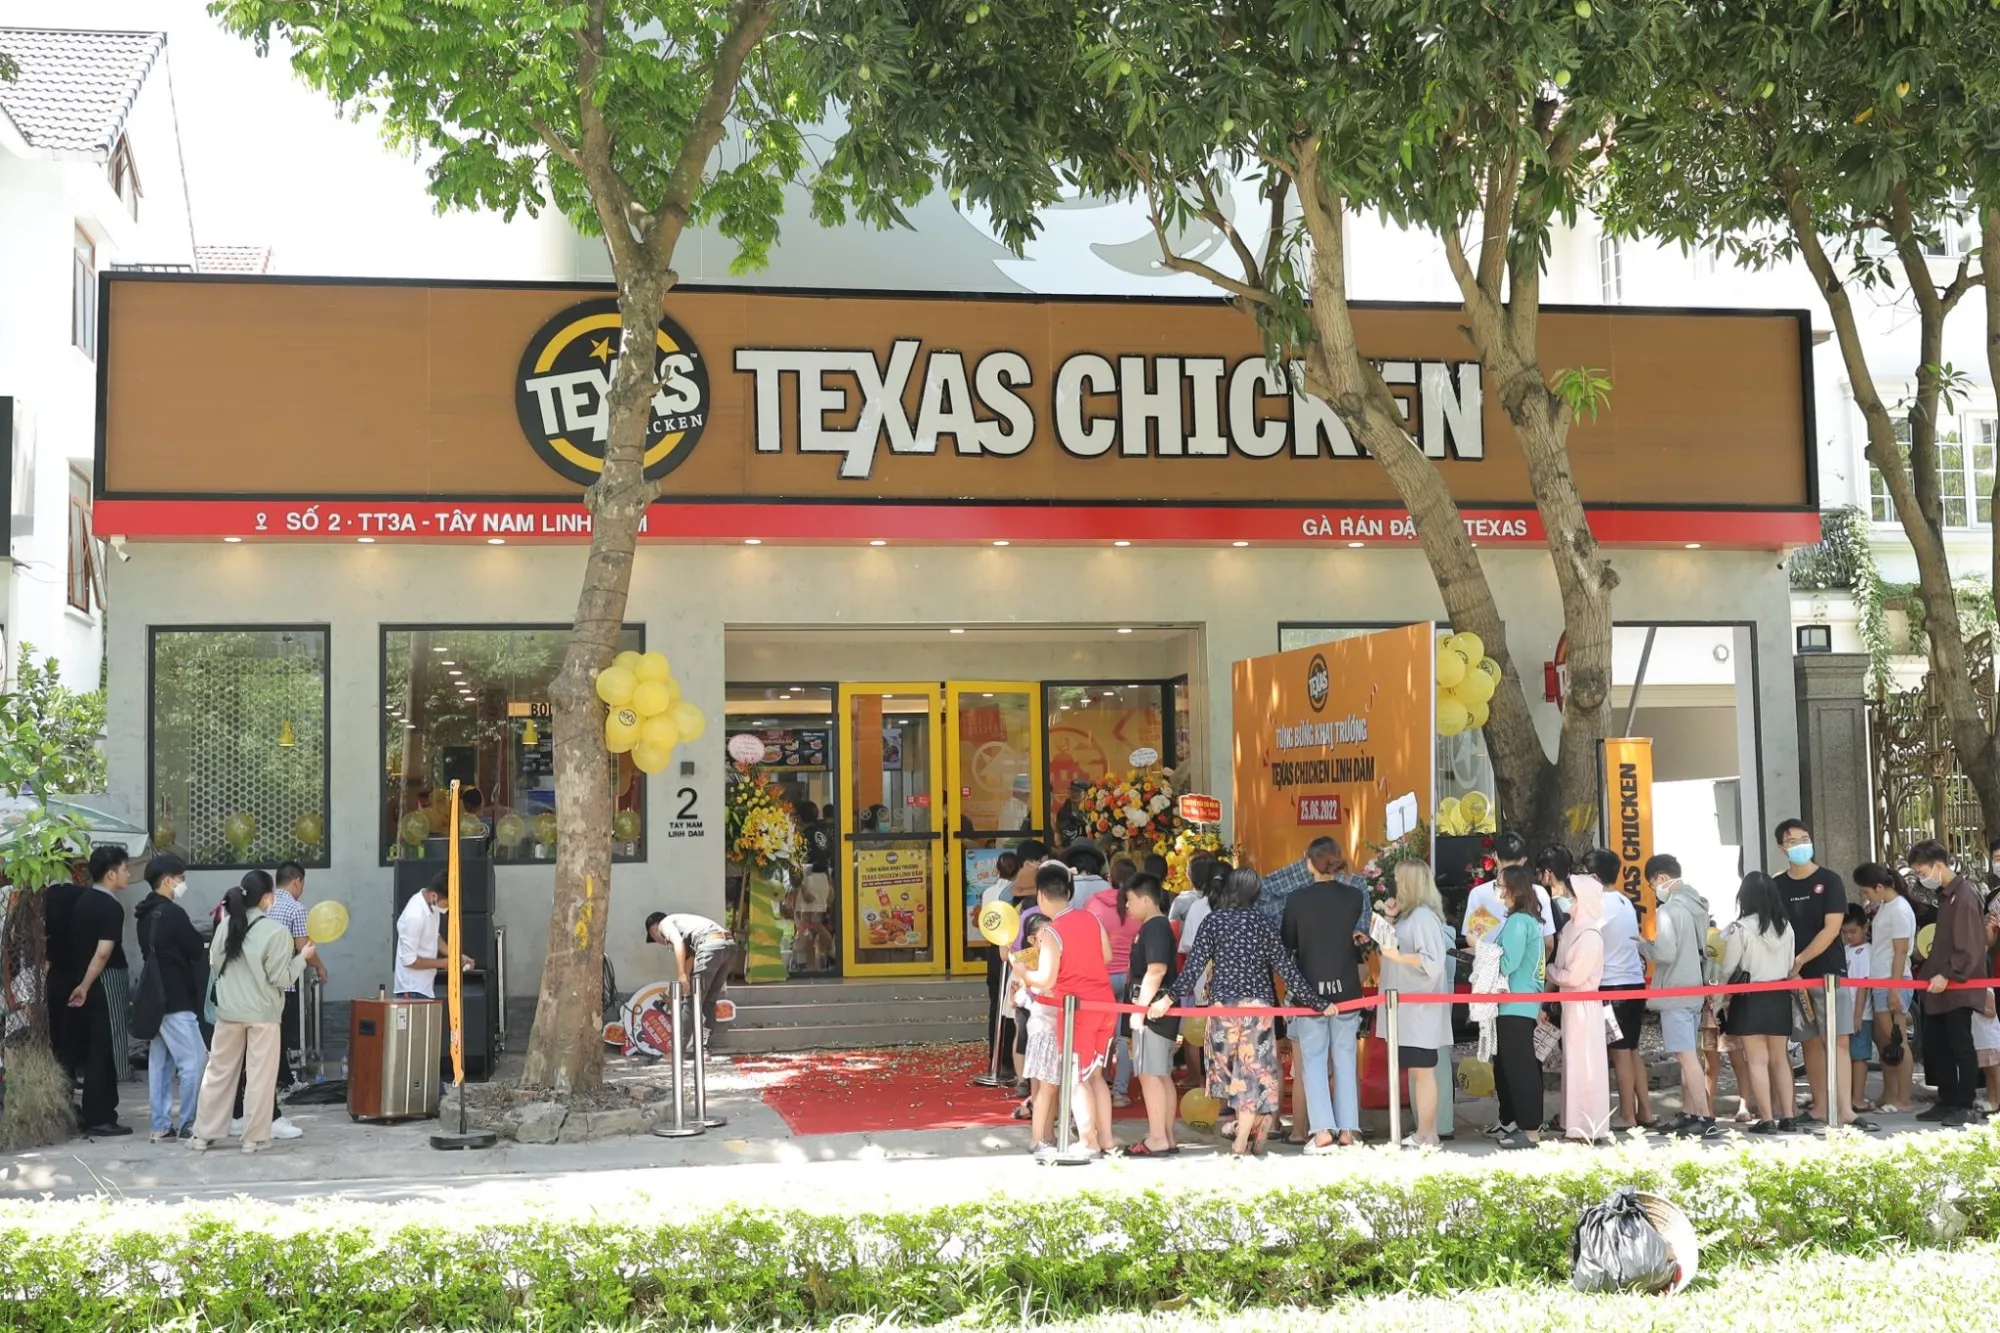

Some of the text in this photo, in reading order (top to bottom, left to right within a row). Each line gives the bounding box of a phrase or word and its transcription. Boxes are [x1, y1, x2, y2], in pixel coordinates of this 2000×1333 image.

[733, 339, 1035, 480] TEXAS
[286, 505, 319, 531] SỐ
[328, 513, 341, 531] 2
[358, 513, 416, 532] TT3A
[434, 509, 477, 532] TÂY
[483, 513, 534, 532] NAM
[542, 514, 592, 532] LINH
[1302, 515, 1333, 536] GÀ
[1340, 515, 1383, 536] RÁN
[1463, 519, 1527, 536] TEXAS
[1271, 760, 1294, 791] TEXAS
[1295, 759, 1330, 785] CHICKEN
[1331, 757, 1352, 783] LINH
[677, 787, 698, 819] 2
[1300, 799, 1337, 821] 25.06.2022
[1620, 763, 1641, 861] CHICKEN
[668, 830, 685, 838] LINH
[669, 821, 703, 829] TAY NAM
